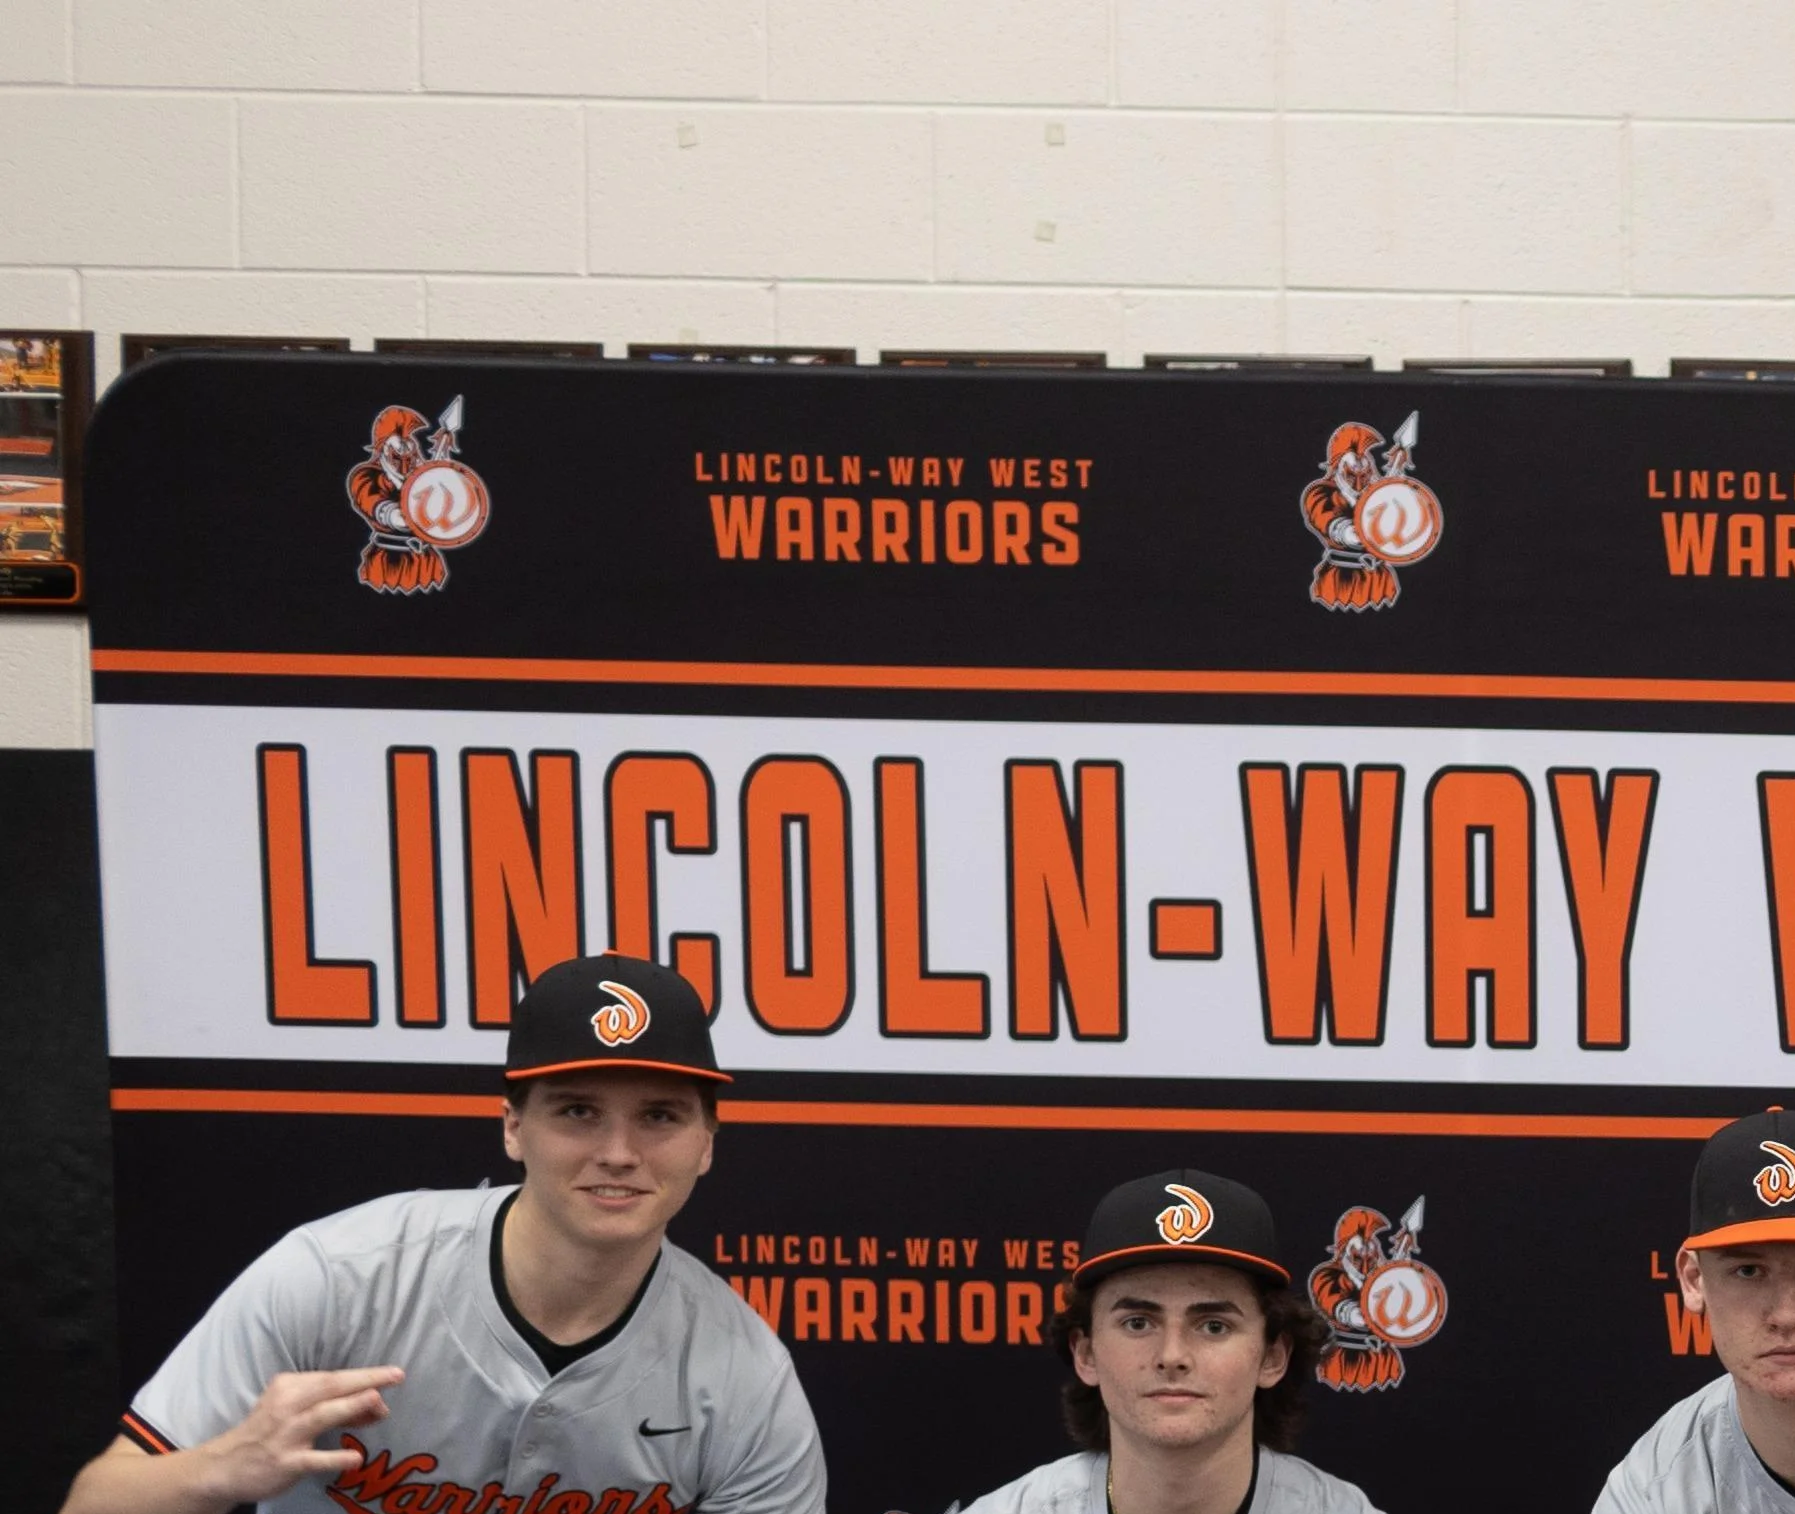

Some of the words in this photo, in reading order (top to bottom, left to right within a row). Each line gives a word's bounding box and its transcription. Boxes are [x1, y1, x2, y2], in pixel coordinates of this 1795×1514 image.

[696, 453, 963, 486] LINCOLN-WAY
[990, 459, 1092, 488] WEST
[710, 495, 1079, 566] WARRIORS
[257, 742, 1660, 1052] LINCOLN-WAY
[716, 1235, 978, 1268] LINCOLN-WAY
[1004, 1240, 1081, 1273] WES
[729, 1276, 1072, 1345] WARRIOR
